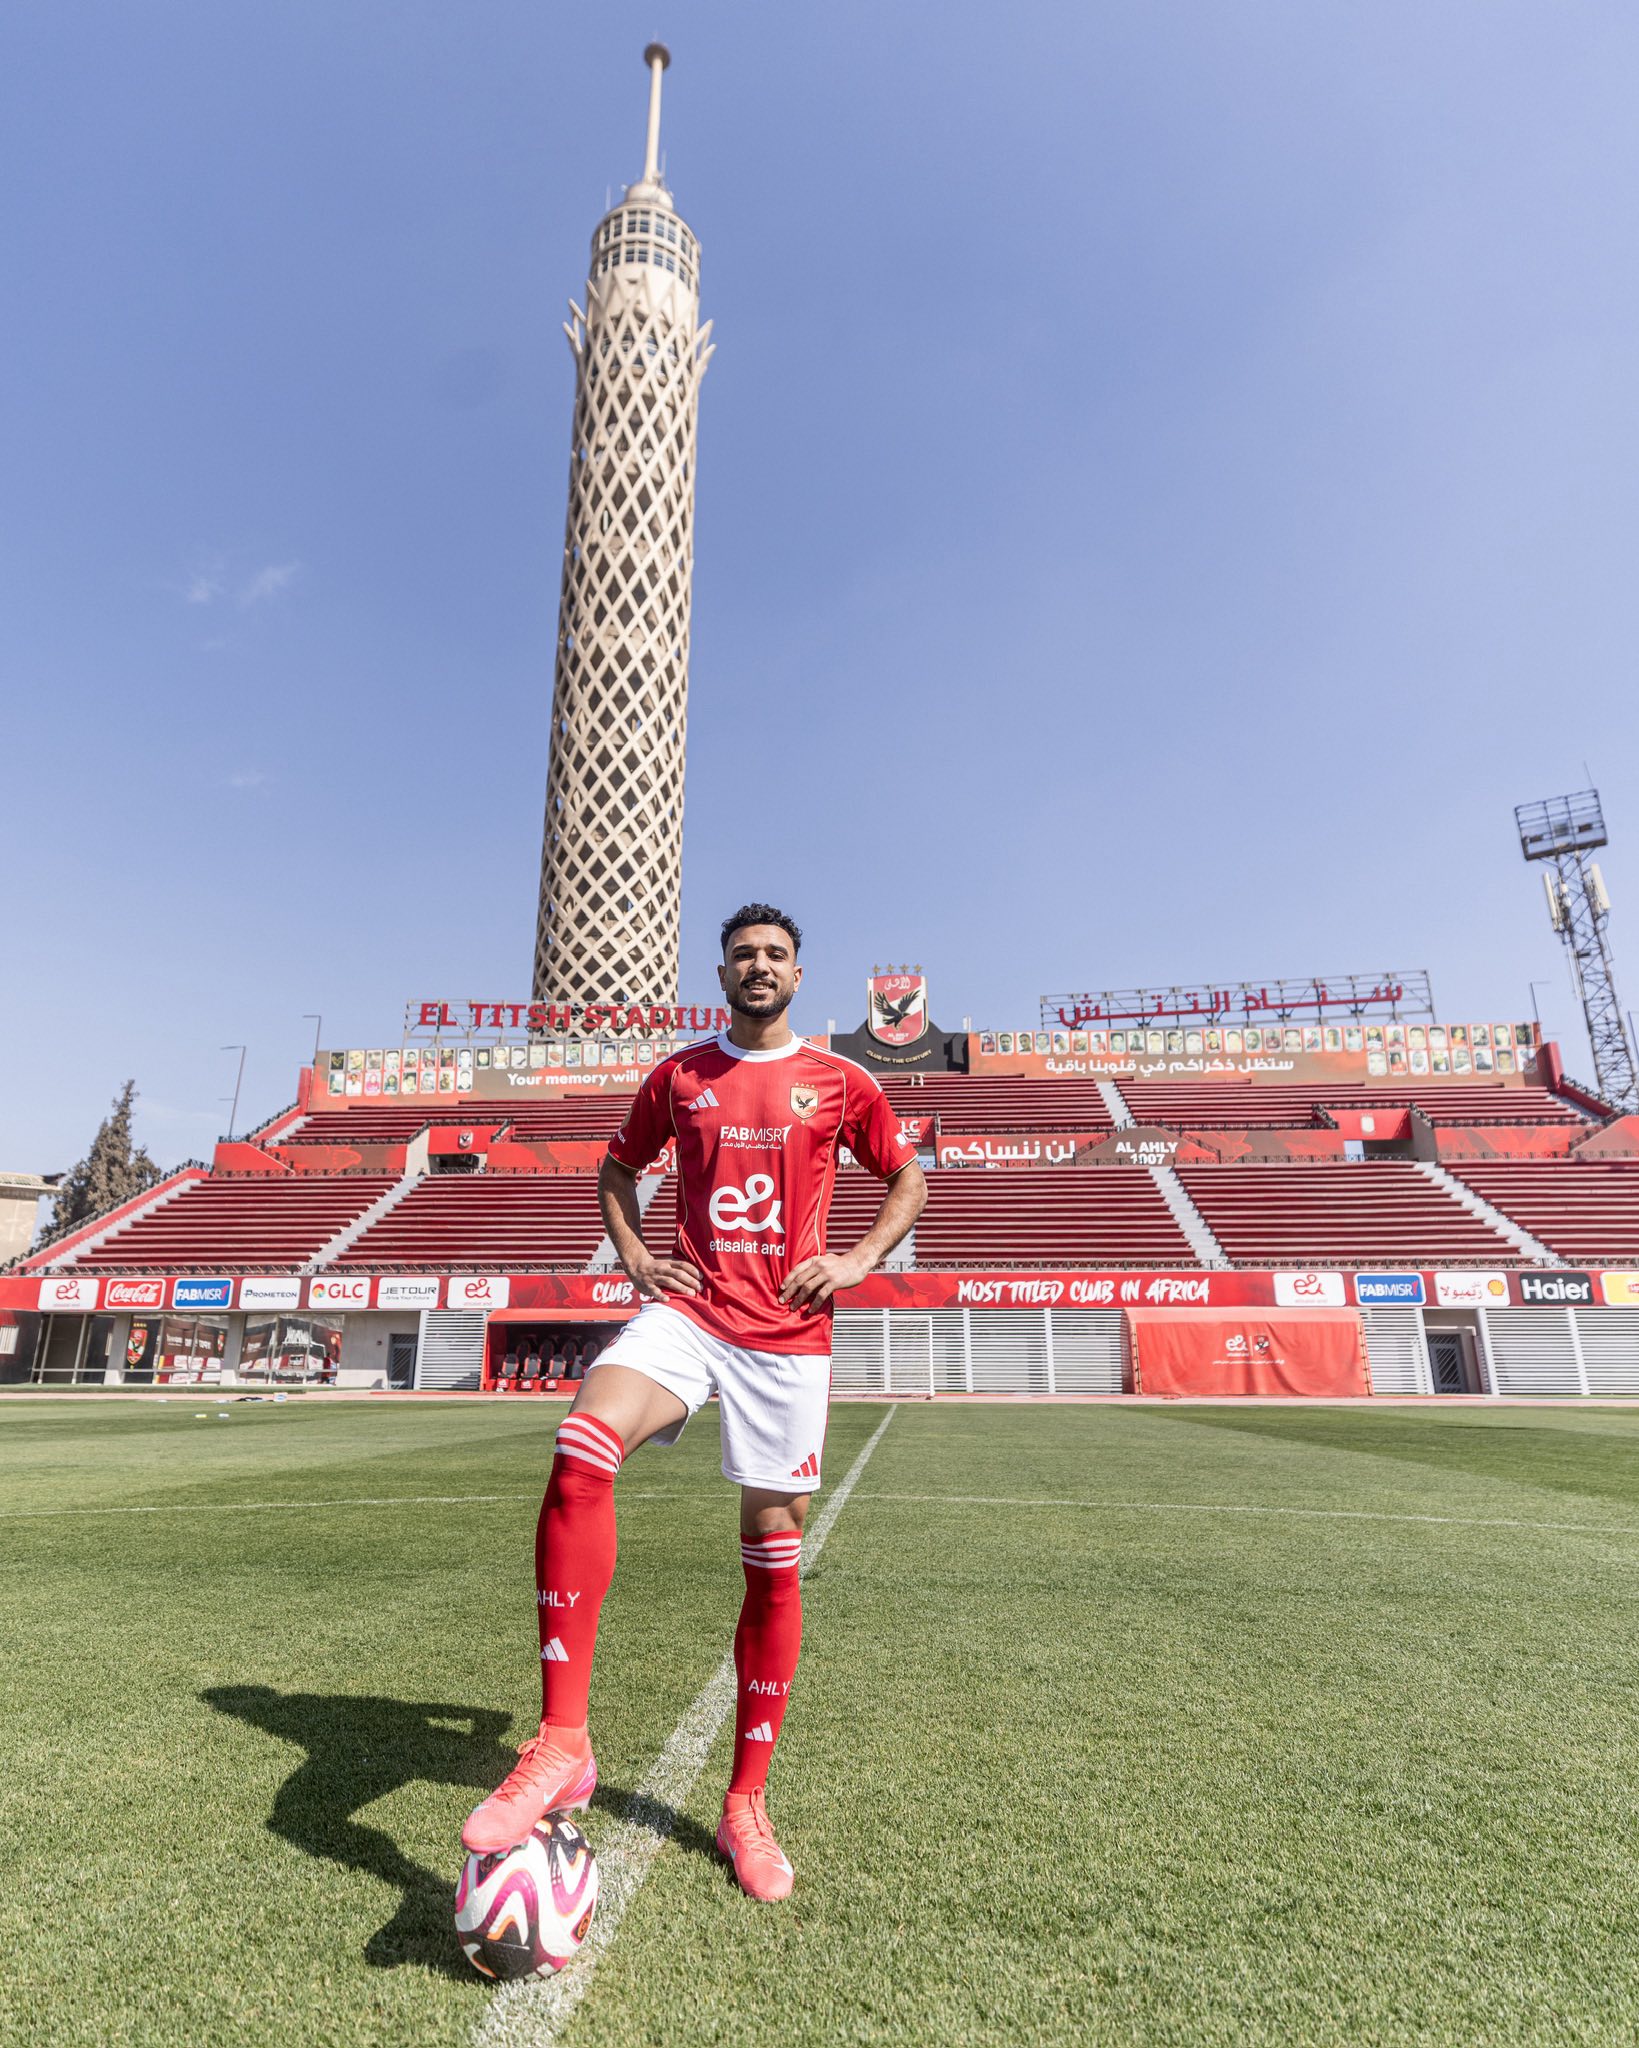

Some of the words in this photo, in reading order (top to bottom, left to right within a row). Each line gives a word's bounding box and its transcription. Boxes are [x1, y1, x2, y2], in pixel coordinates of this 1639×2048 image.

[420, 1003, 457, 1026] EL
[469, 1003, 571, 1029] TITSH
[866, 1049, 882, 1061] CLUB
[905, 1049, 932, 1063] CENTURY
[1045, 1058, 1086, 1073] باقية
[1089, 1058, 1137, 1074] قلوبنا
[1139, 1060, 1167, 1078] في
[1170, 1058, 1236, 1075] ذكراكم
[1237, 1057, 1294, 1073] ستظل
[507, 1073, 542, 1086] Your
[545, 1072, 608, 1087] memory
[611, 1070, 639, 1083] will
[720, 1126, 783, 1143] FABMISR
[940, 1138, 1039, 1164] ننساكم
[1045, 1139, 1076, 1163] لن
[1116, 1141, 1136, 1153] AL
[1138, 1141, 1178, 1154] AHLY
[1130, 1153, 1165, 1165] 1907
[710, 1238, 758, 1254] etisalat
[761, 1242, 785, 1257] and
[176, 1287, 222, 1301] FABMISR
[328, 1283, 364, 1299] GLC
[380, 1286, 437, 1295] JETOUR
[592, 1281, 635, 1305] CLUB
[957, 1280, 1008, 1303] MOST
[1007, 1280, 1064, 1304] TITLED
[1069, 1280, 1115, 1304] CLUB
[1119, 1279, 1141, 1301] IN
[1144, 1278, 1210, 1305] AFRICA
[1359, 1283, 1413, 1297] FABMISR
[1520, 1278, 1589, 1300] Haier
[537, 1589, 581, 1608] AHLY
[748, 1679, 790, 1696] AHLY
